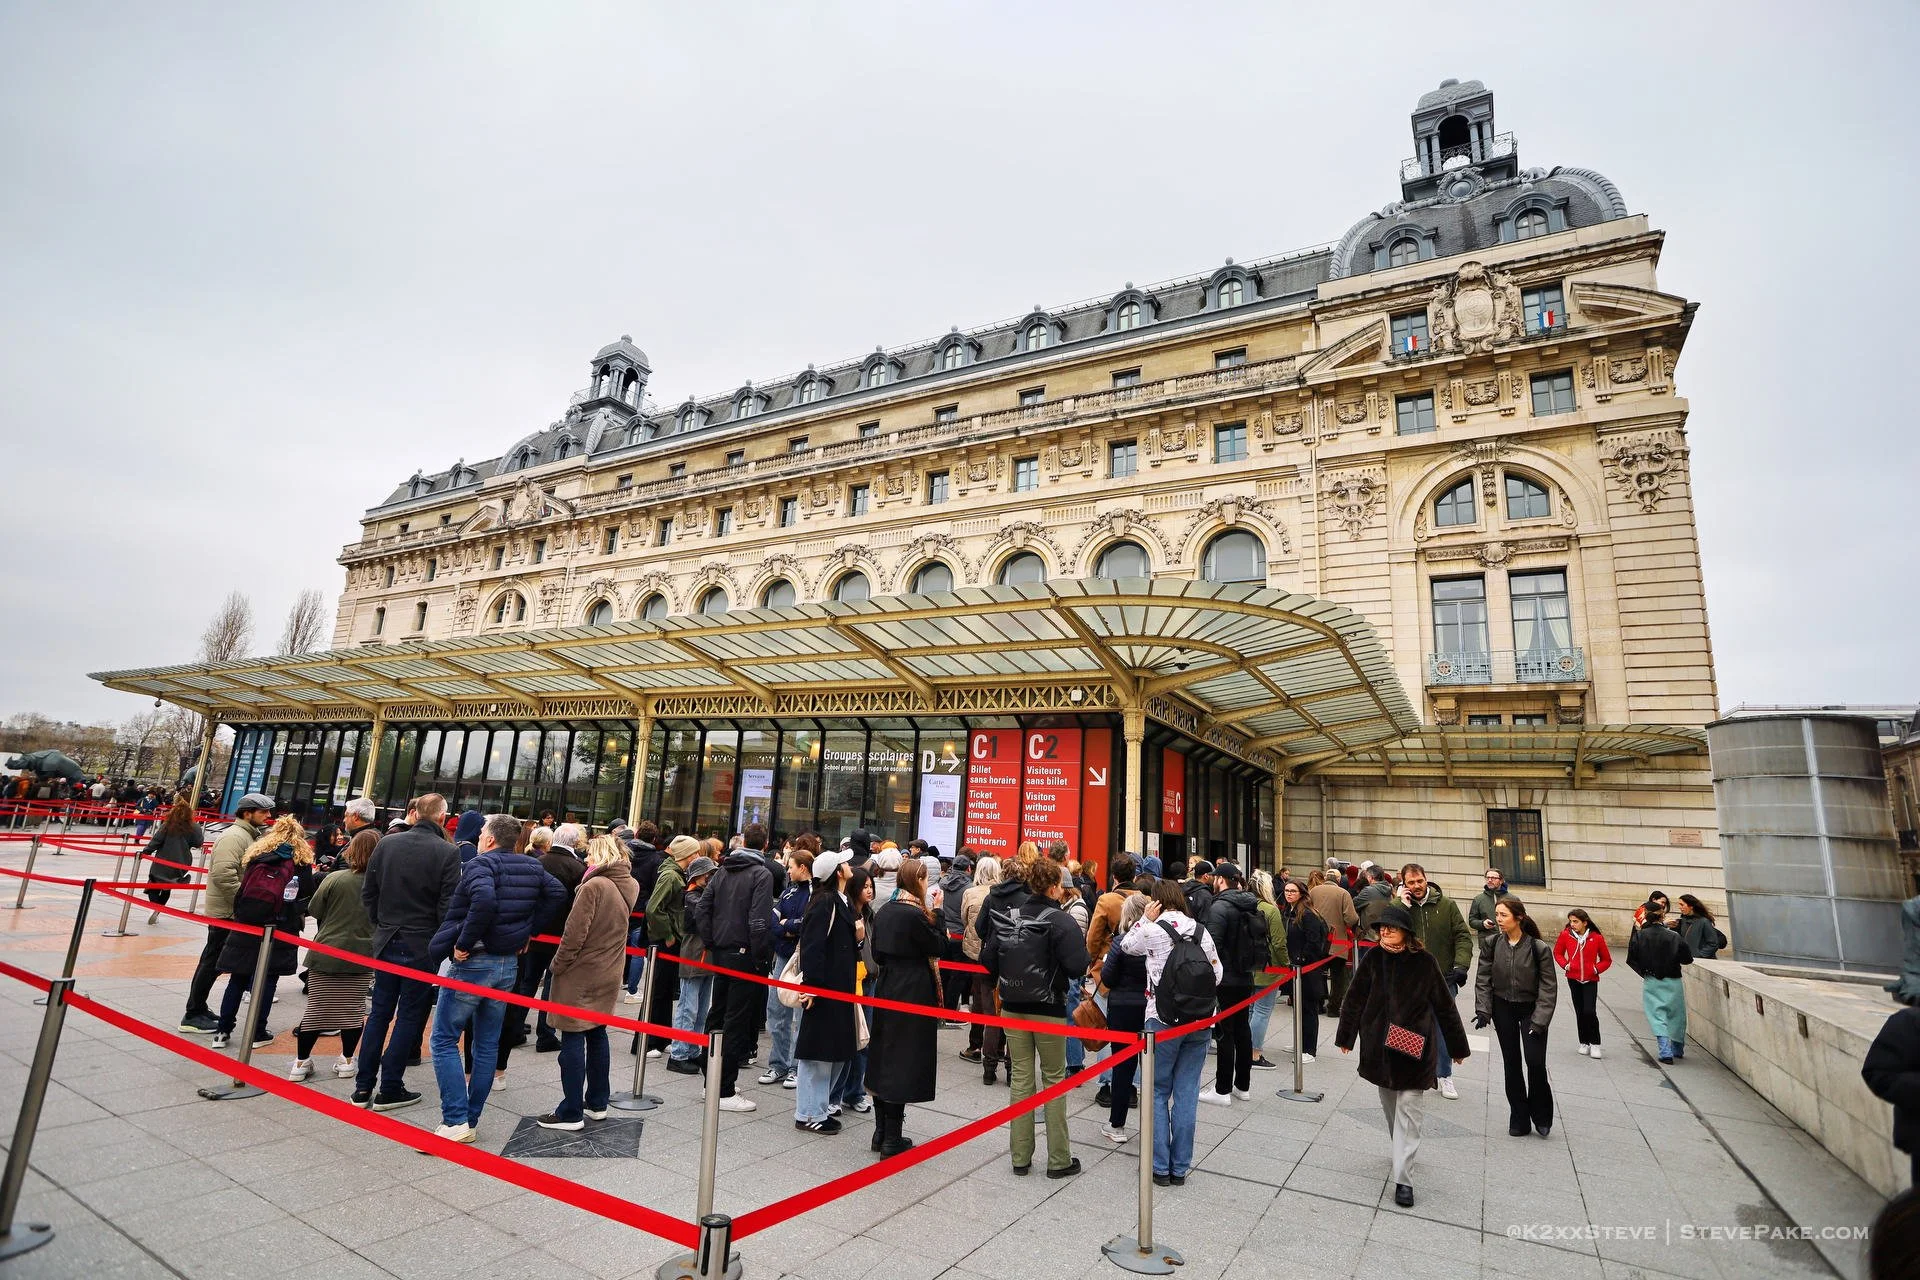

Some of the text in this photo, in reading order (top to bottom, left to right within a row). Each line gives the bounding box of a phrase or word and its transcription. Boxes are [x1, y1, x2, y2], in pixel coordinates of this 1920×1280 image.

[244, 733, 250, 746] A
[259, 733, 265, 746] A
[973, 734, 998, 759] C1
[1029, 733, 1059, 759] C2
[823, 748, 914, 764] Groupes scolaires
[921, 750, 936, 773] D
[970, 764, 991, 774] Billet
[1027, 765, 1062, 775] Visiteurs
[989, 776, 1017, 785] horaire
[1046, 777, 1068, 786] billet
[969, 790, 993, 799] Ticket
[1025, 791, 1056, 801] Visitors
[968, 801, 997, 810] without
[1025, 803, 1056, 812] without
[1175, 791, 1181, 815] C
[967, 810, 1000, 820] time slot
[1024, 813, 1048, 822] ticket
[967, 825, 992, 835] Billete
[1023, 828, 1064, 839] Visitantes
[966, 836, 1007, 847] sin horario
[1037, 839, 1051, 849] bill
